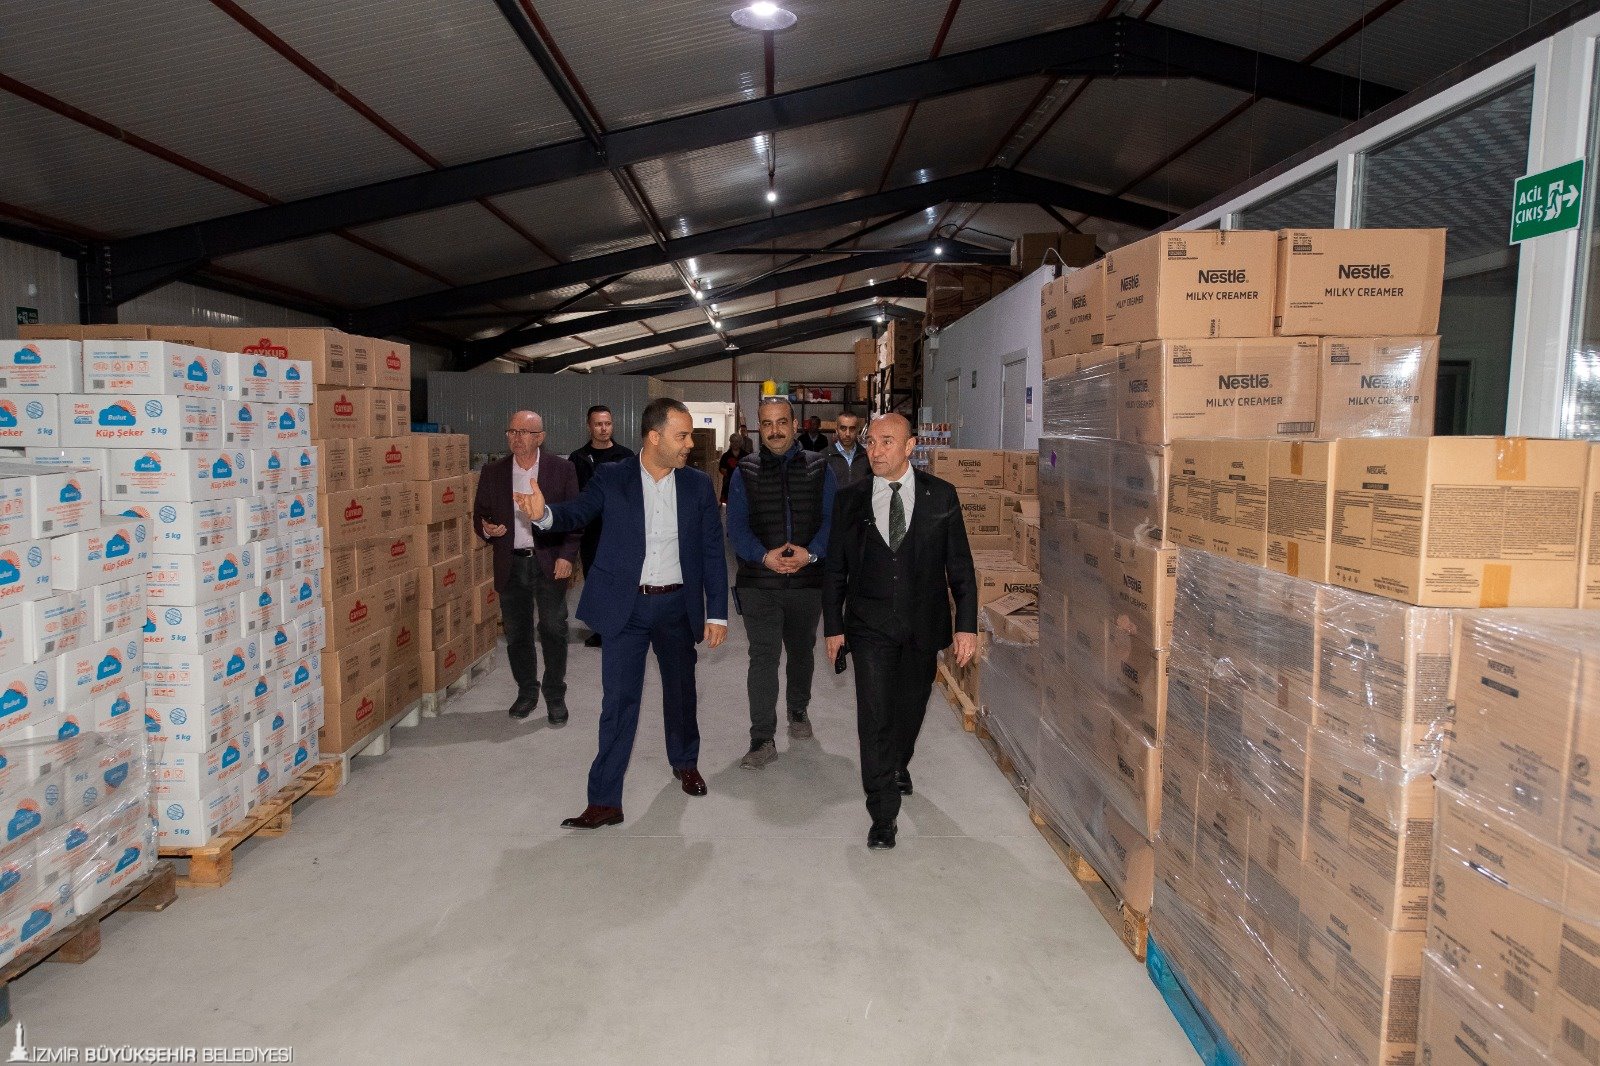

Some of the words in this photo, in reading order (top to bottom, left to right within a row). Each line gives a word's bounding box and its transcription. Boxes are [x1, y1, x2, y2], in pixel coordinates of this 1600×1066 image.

[1519, 185, 1542, 205] ACİL
[1516, 205, 1543, 227] ÇIKIŞ
[1339, 264, 1391, 279] Nestlé
[1199, 270, 1246, 284] Nestlé
[1186, 292, 1214, 301] MILKY
[1216, 291, 1259, 300] CREAMER
[1324, 288, 1356, 297] MILKY
[1358, 288, 1404, 297] CREAMER
[1219, 374, 1270, 389] Nestlé
[1206, 398, 1234, 407] MILKY
[1238, 397, 1283, 406] CREAMER
[1348, 397, 1375, 405] MILKY
[96, 429, 114, 438] Küp
[117, 429, 144, 438] Şeker
[158, 427, 167, 435] kg
